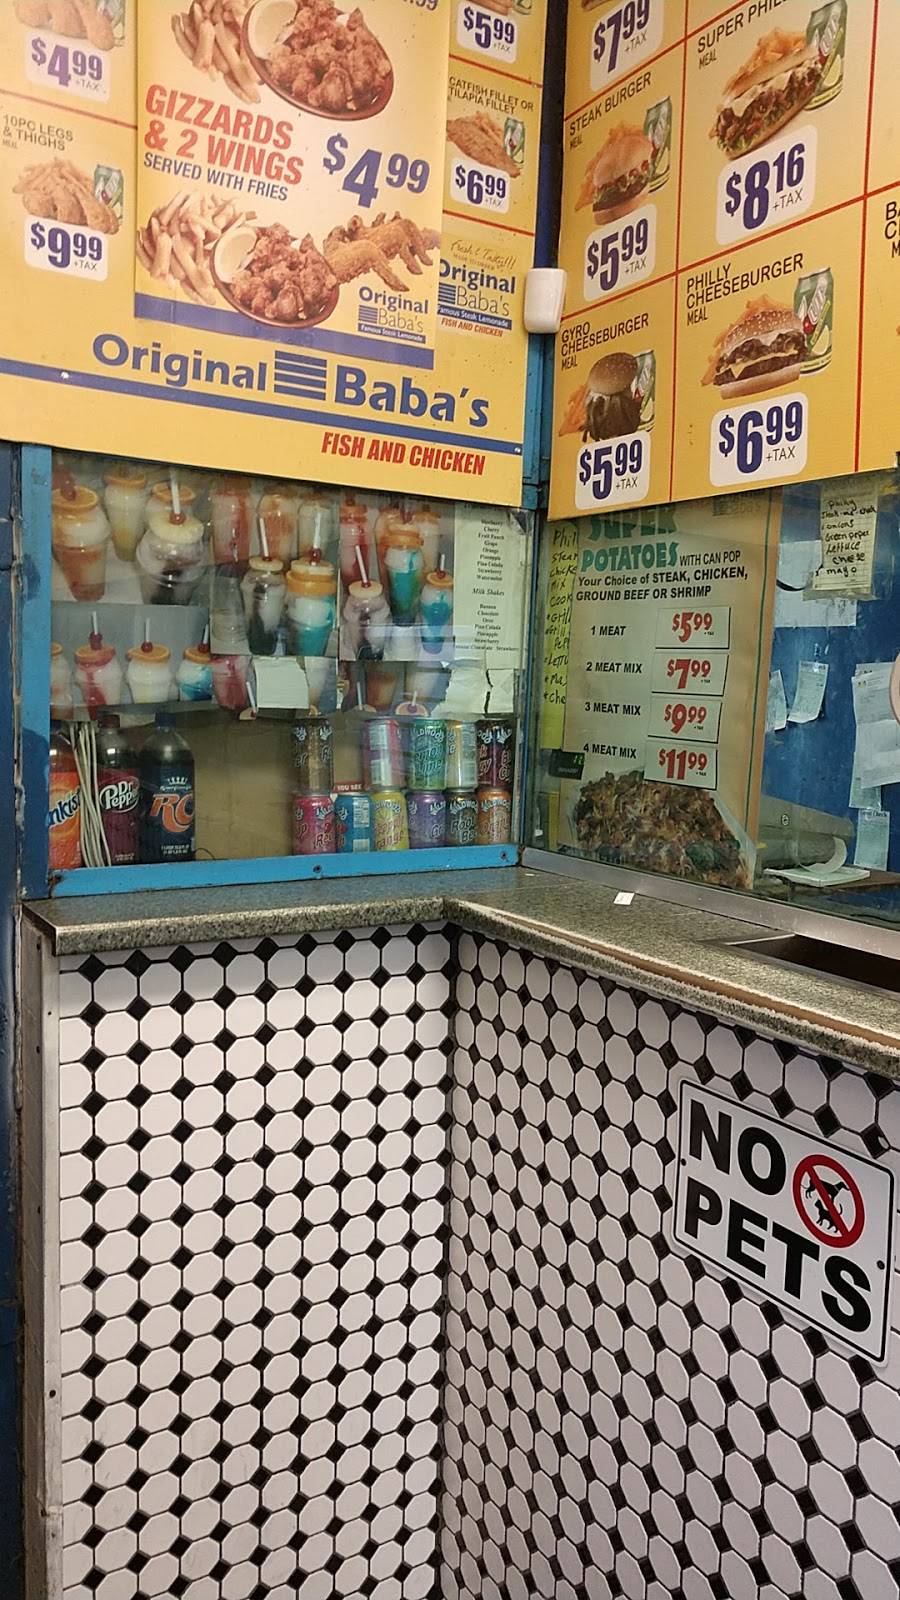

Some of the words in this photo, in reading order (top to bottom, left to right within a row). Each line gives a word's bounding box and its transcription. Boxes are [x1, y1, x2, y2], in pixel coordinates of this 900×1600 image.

[463, 6, 515, 49] $599
[593, 0, 649, 74] $799
[625, 31, 648, 52] +TAX
[698, 13, 744, 53] SUPER
[31, 37, 103, 87] $499
[699, 50, 717, 70] MEAL
[449, 77, 487, 96] CATFISH
[489, 89, 519, 106] FILLET
[520, 100, 533, 111] OR
[449, 86, 483, 106] TILAPIA
[486, 99, 515, 114] FILLET
[569, 103, 602, 136] STEAK
[605, 72, 651, 112] BURGER
[4, 114, 36, 131] 10PC
[40, 123, 73, 141] LEGS
[145, 84, 294, 150] GIZZARDS
[3, 126, 12, 137] &
[16, 129, 65, 151] THIGHS
[144, 119, 169, 152] &
[176, 128, 198, 158] 2
[208, 135, 304, 186] WINGS
[143, 152, 201, 180] SERVED
[207, 170, 244, 191] WITH
[247, 179, 288, 201] FRIES
[322, 132, 430, 209] $499
[455, 165, 506, 205] $699
[725, 143, 805, 230] $816
[772, 188, 803, 211] +TAX
[30, 222, 103, 269] $999
[587, 218, 648, 291] $599
[625, 258, 647, 275] +TAX
[686, 253, 804, 309] CHEESEBURGER
[687, 263, 731, 294] PHILLY
[359, 286, 428, 314] Original
[457, 285, 509, 316] Baba's
[379, 308, 423, 333] Baba's
[441, 318, 457, 327] FISH
[458, 321, 473, 331] AND
[474, 325, 503, 337] CHICKEN
[562, 322, 590, 342] GYRO
[687, 307, 708, 326] MEAL
[561, 313, 649, 357] CHEESEBURGER
[561, 355, 577, 371] MEAL
[92, 333, 266, 391] Original
[335, 364, 489, 427] Baba's
[719, 401, 803, 474] $699
[321, 432, 364, 459] FISH
[367, 439, 406, 465] AND
[409, 445, 486, 476] CHICKEN
[579, 439, 642, 500] $599
[766, 446, 795, 462] +TAX
[616, 477, 637, 490] +TAX
[587, 504, 677, 541] SUPER
[581, 541, 679, 572] POTATOES
[680, 554, 701, 566] WITH
[703, 553, 721, 565] CAN
[723, 550, 740, 563] POP
[578, 577, 602, 587] Your
[605, 575, 637, 586] Choice
[640, 573, 649, 584] of
[653, 571, 690, 584] STEAK,
[694, 566, 748, 581] CHICKEN,
[577, 591, 621, 601] GROUND
[624, 589, 650, 600] BEEF
[653, 588, 667, 599] OR
[670, 585, 712, 598] SHRIMP
[591, 626, 595, 636] 1
[600, 625, 626, 636] MEAT
[672, 611, 713, 643] $599
[586, 662, 592, 672] 2
[595, 662, 622, 673] MEAT
[623, 663, 642, 673] MIX
[667, 659, 711, 690] $799
[585, 702, 591, 712] 3
[593, 702, 620, 714] MEAT
[623, 704, 641, 716] MIX
[664, 703, 707, 734] $999
[583, 743, 589, 753] 4
[591, 744, 618, 756] MEAT
[619, 746, 637, 759] MIX
[659, 748, 707, 780] $1199
[119, 780, 134, 795] Dr
[149, 793, 194, 833] RC
[689, 1098, 787, 1196] NO
[684, 1175, 872, 1333] PETS
